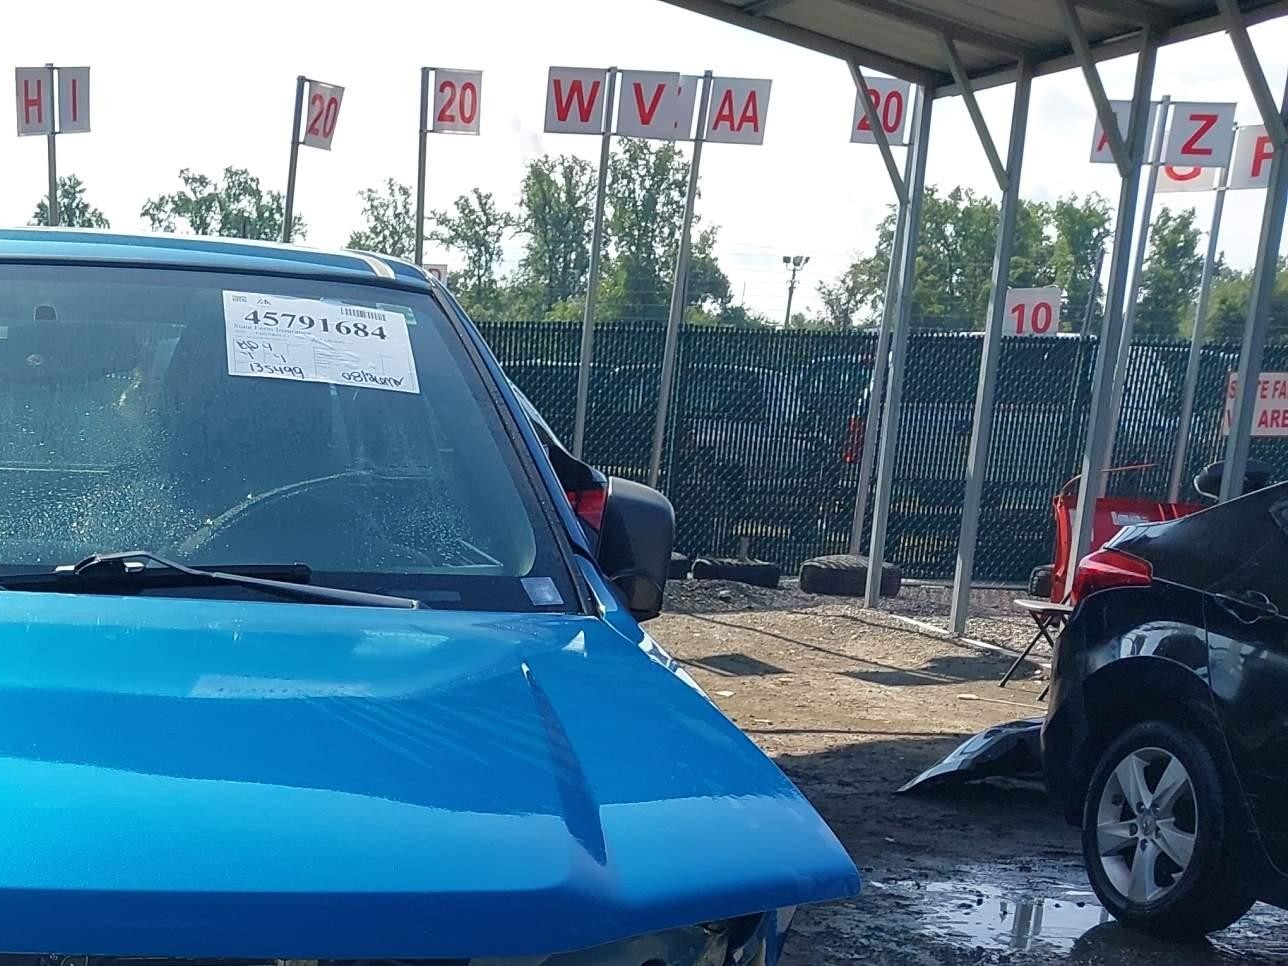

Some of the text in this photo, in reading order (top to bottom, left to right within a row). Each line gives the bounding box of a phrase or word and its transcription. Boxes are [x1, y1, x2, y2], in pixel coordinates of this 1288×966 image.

[23, 79, 42, 124] H
[308, 93, 339, 138] 20
[437, 80, 477, 124] 20
[553, 79, 601, 123] W
[632, 82, 666, 126] V
[712, 89, 759, 133] AA
[856, 88, 903, 133] 20
[1180, 114, 1219, 156] Z
[244, 310, 388, 341] 45791684
[1011, 302, 1052, 335] 10
